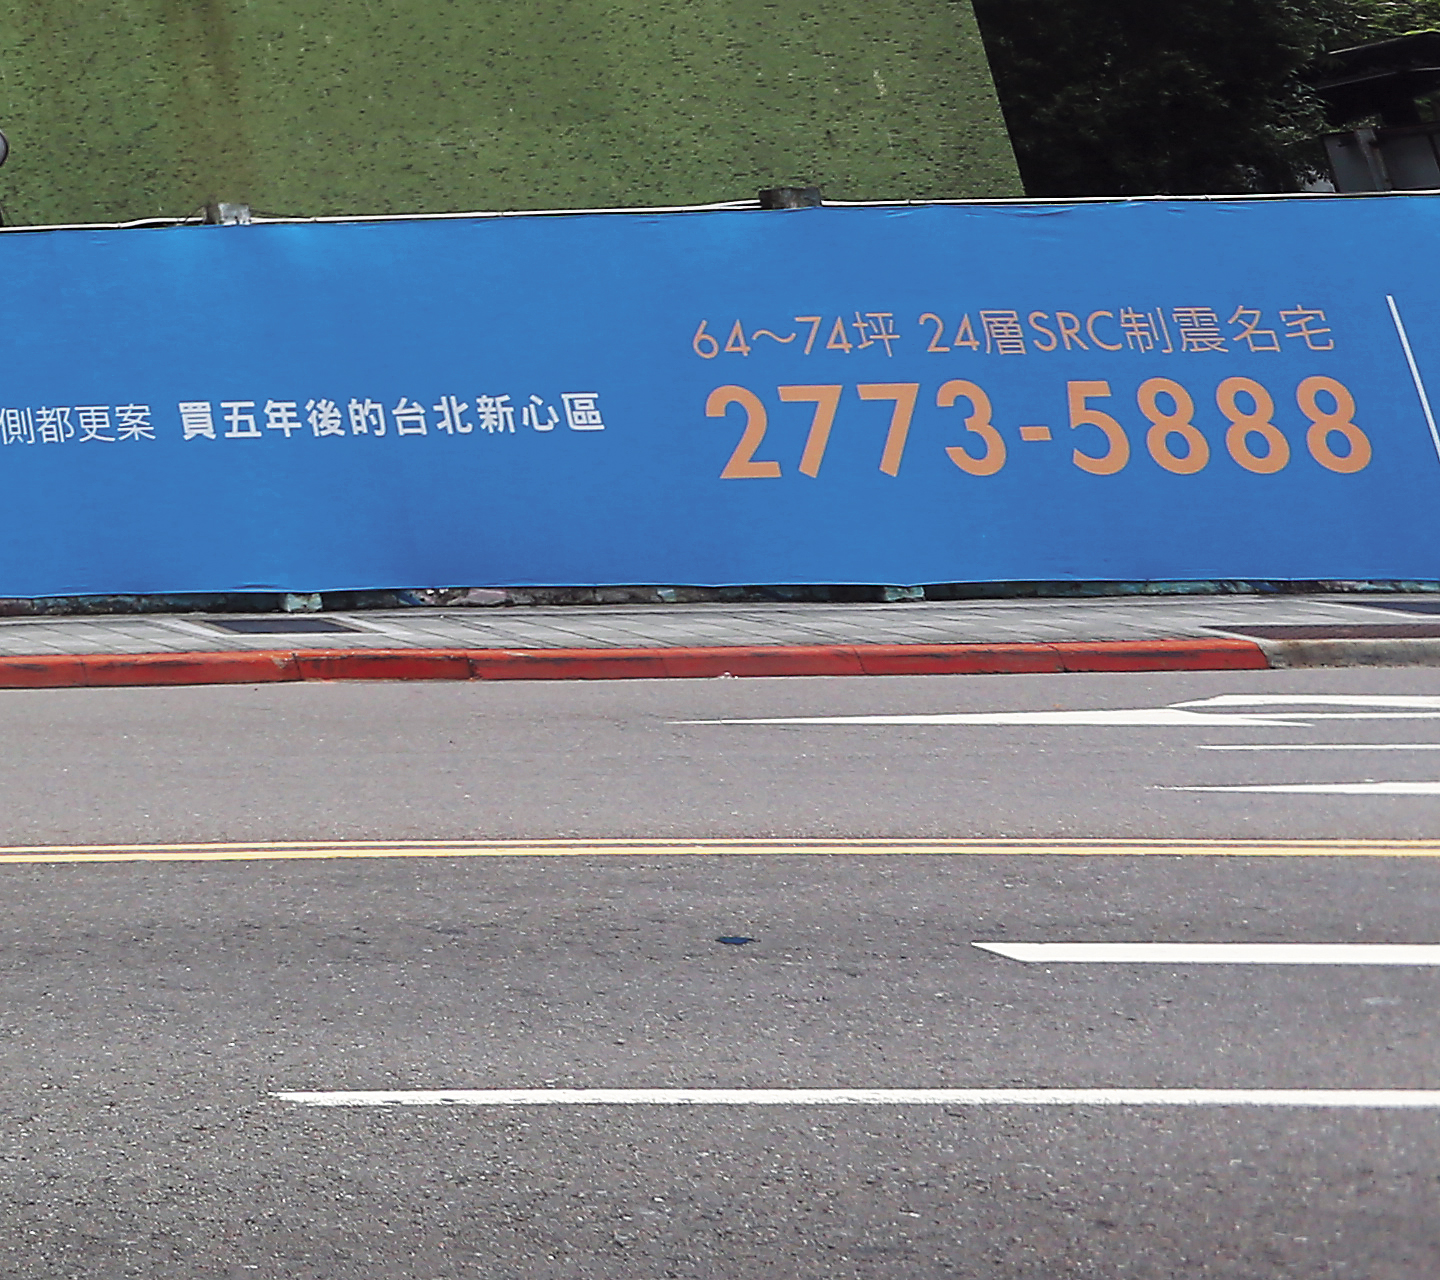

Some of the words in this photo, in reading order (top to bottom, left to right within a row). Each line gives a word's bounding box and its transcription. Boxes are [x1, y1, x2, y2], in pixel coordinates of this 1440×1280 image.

[918, 304, 1335, 356] 24層SRC制震名宅
[179, 391, 606, 441] 買五年後的台北新心區
[704, 375, 1372, 479] 2773-5888
